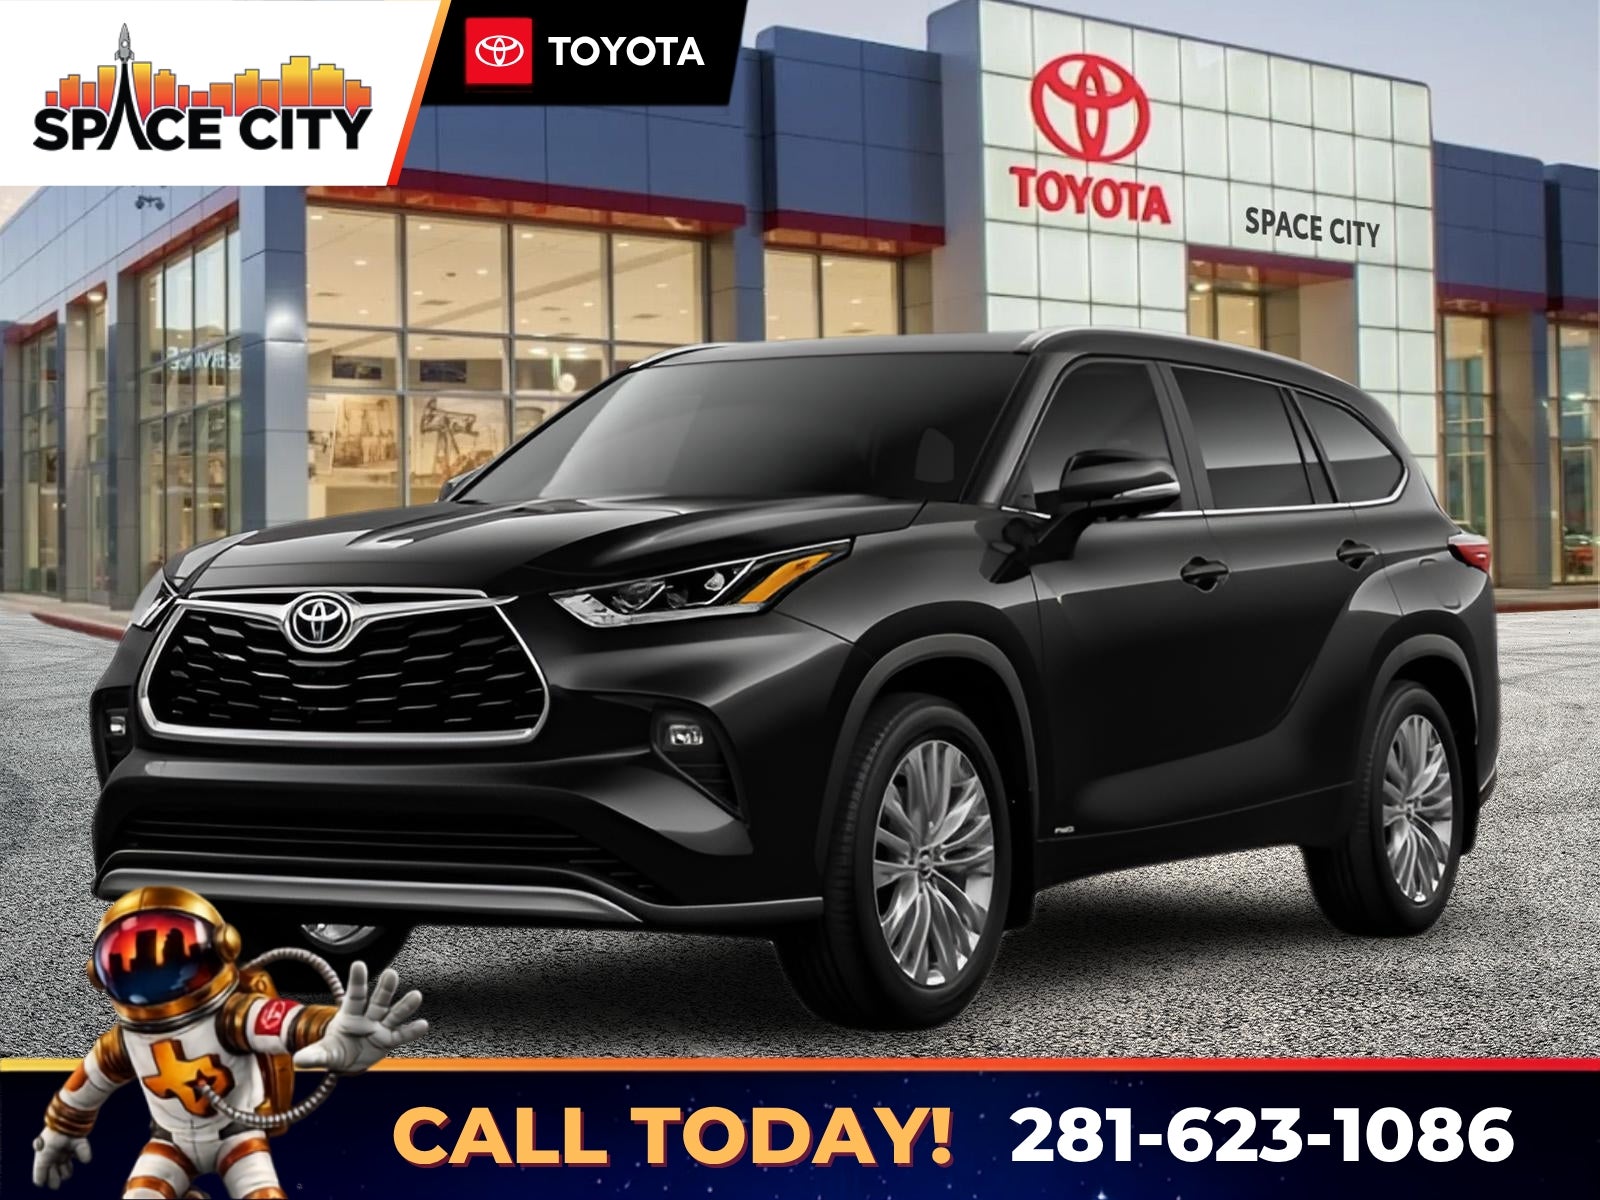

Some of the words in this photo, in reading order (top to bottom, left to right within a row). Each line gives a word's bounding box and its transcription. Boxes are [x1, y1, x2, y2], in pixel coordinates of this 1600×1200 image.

[1009, 166, 1171, 224] TOYOTA
[1246, 207, 1322, 241] SPACE
[1330, 218, 1380, 247] CITY
